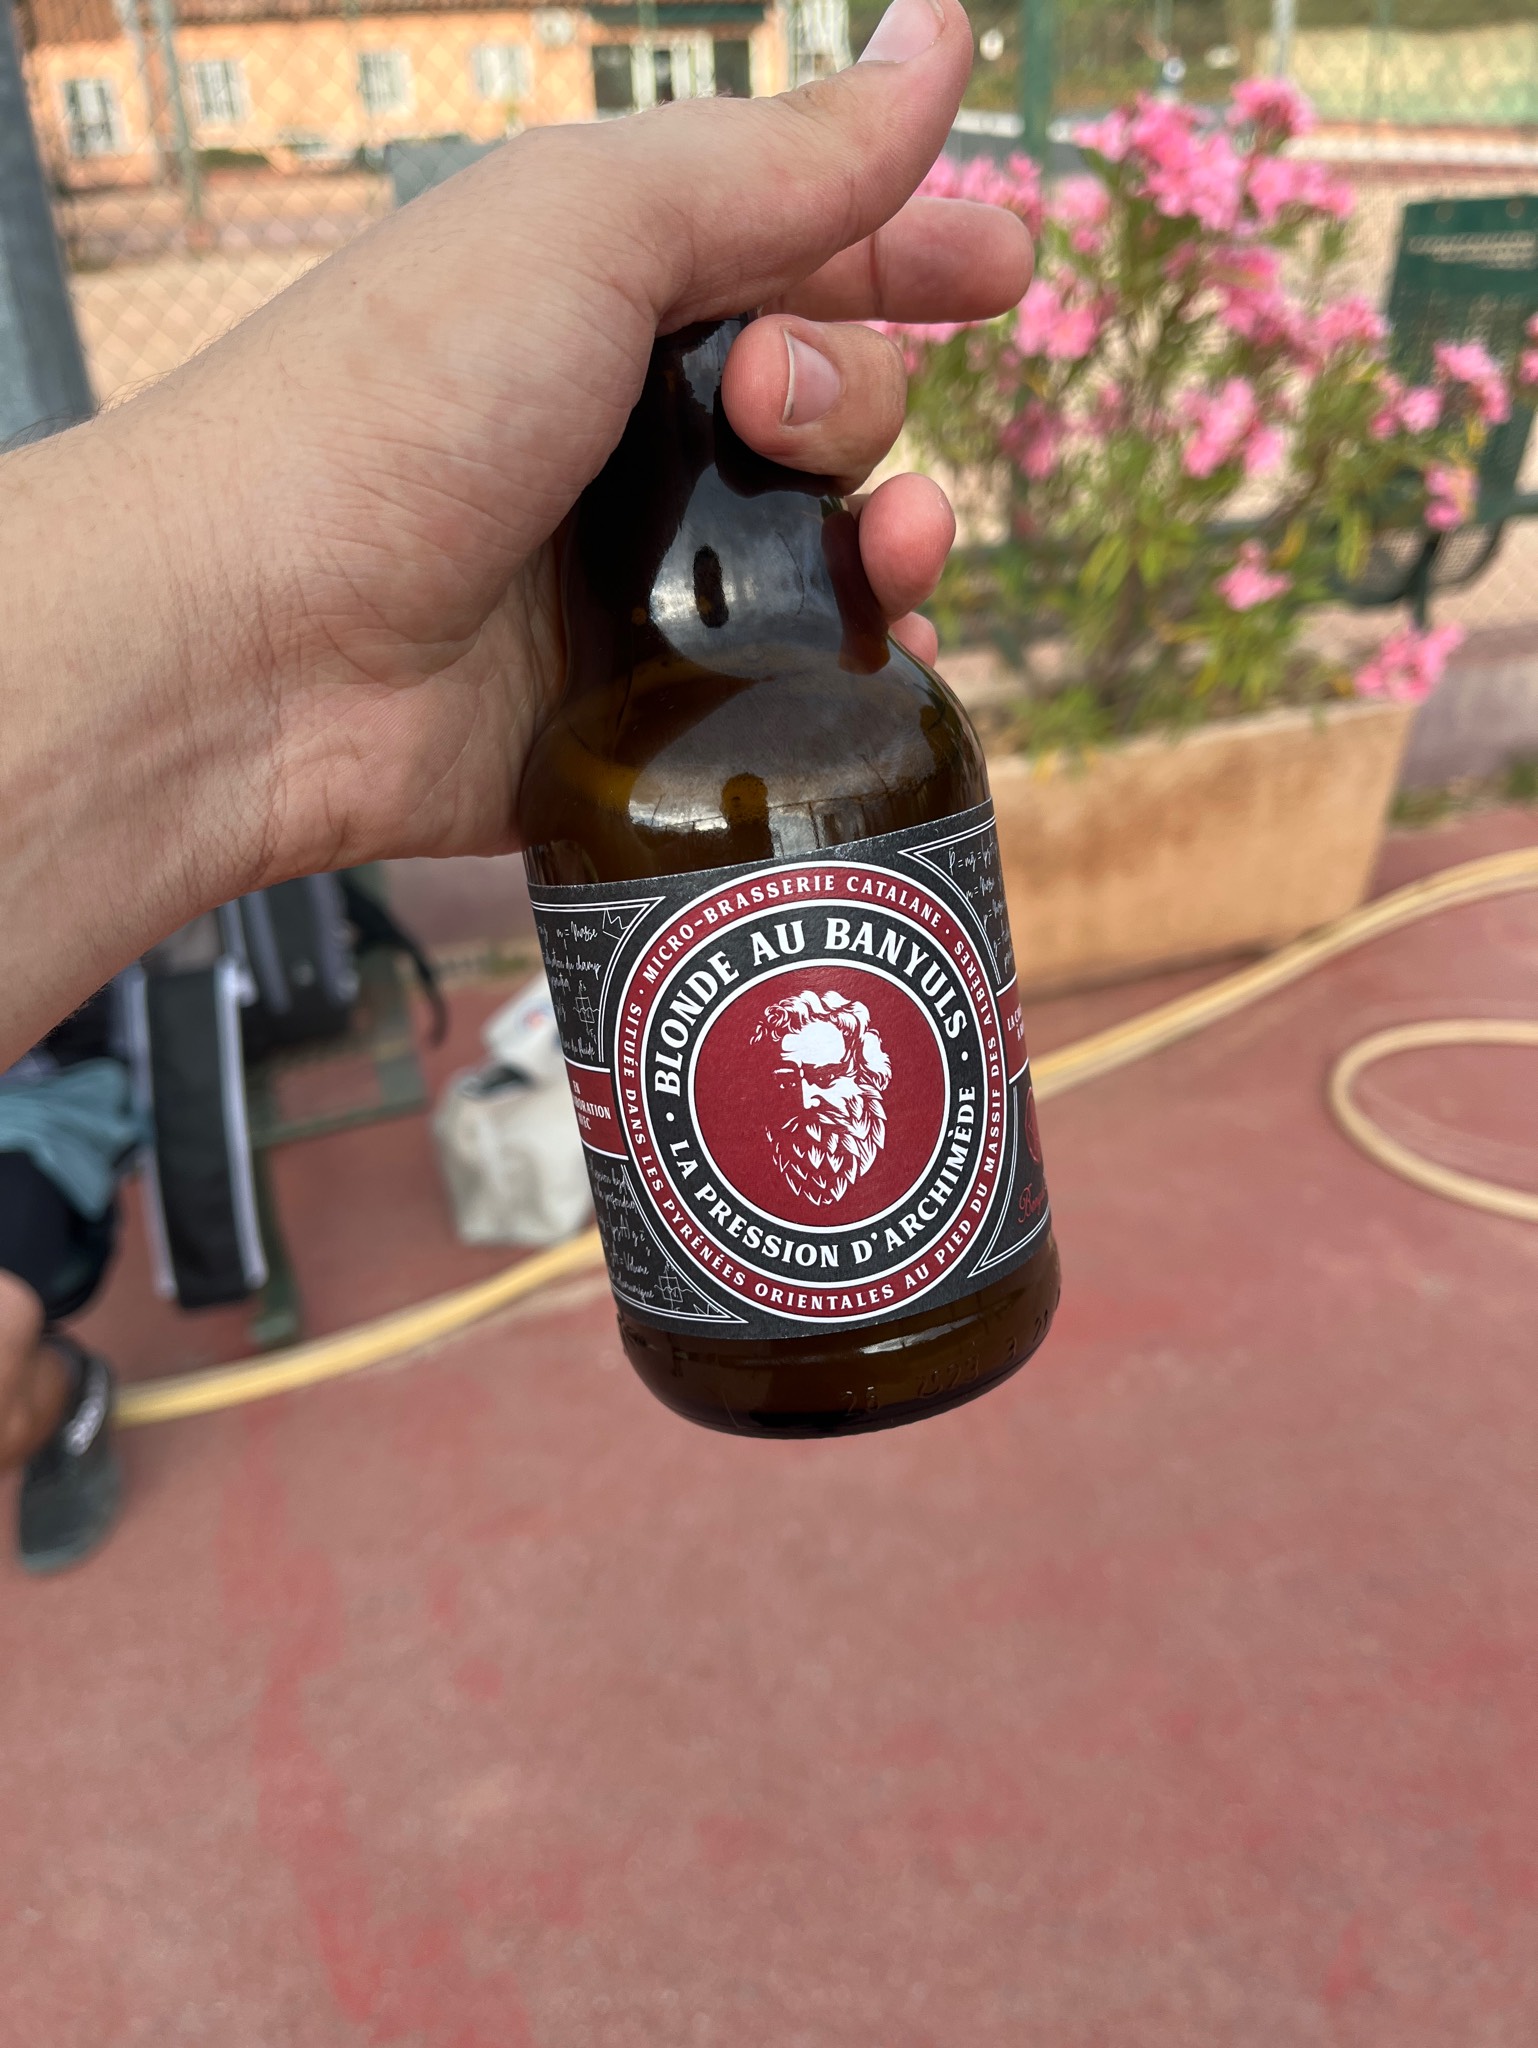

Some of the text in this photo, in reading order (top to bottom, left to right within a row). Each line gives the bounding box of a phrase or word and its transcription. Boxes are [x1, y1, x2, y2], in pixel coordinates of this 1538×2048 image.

[643, 875, 835, 985] MICRO-BRASSERIE
[847, 876, 942, 928] CATALANE
[654, 918, 968, 1097] BLONDE AU BANYULS
[953, 940, 993, 1026] ALBÈRES
[623, 1002, 642, 1079] SITUÉE
[987, 1036, 1000, 1078] DES
[625, 1088, 647, 1145] DANS
[983, 1088, 1001, 1174] MASSIF
[641, 1155, 664, 1192] LES
[669, 1139, 699, 1180] LA
[693, 1182, 840, 1268] PRESSION
[850, 1086, 976, 1265] D'ARCHIMÈDE
[969, 1182, 988, 1214] DU
[662, 1198, 746, 1286] PYRÉNÉES
[934, 1219, 971, 1265] PIED
[754, 1283, 895, 1311] ORIENTALES
[904, 1263, 930, 1290] AU
